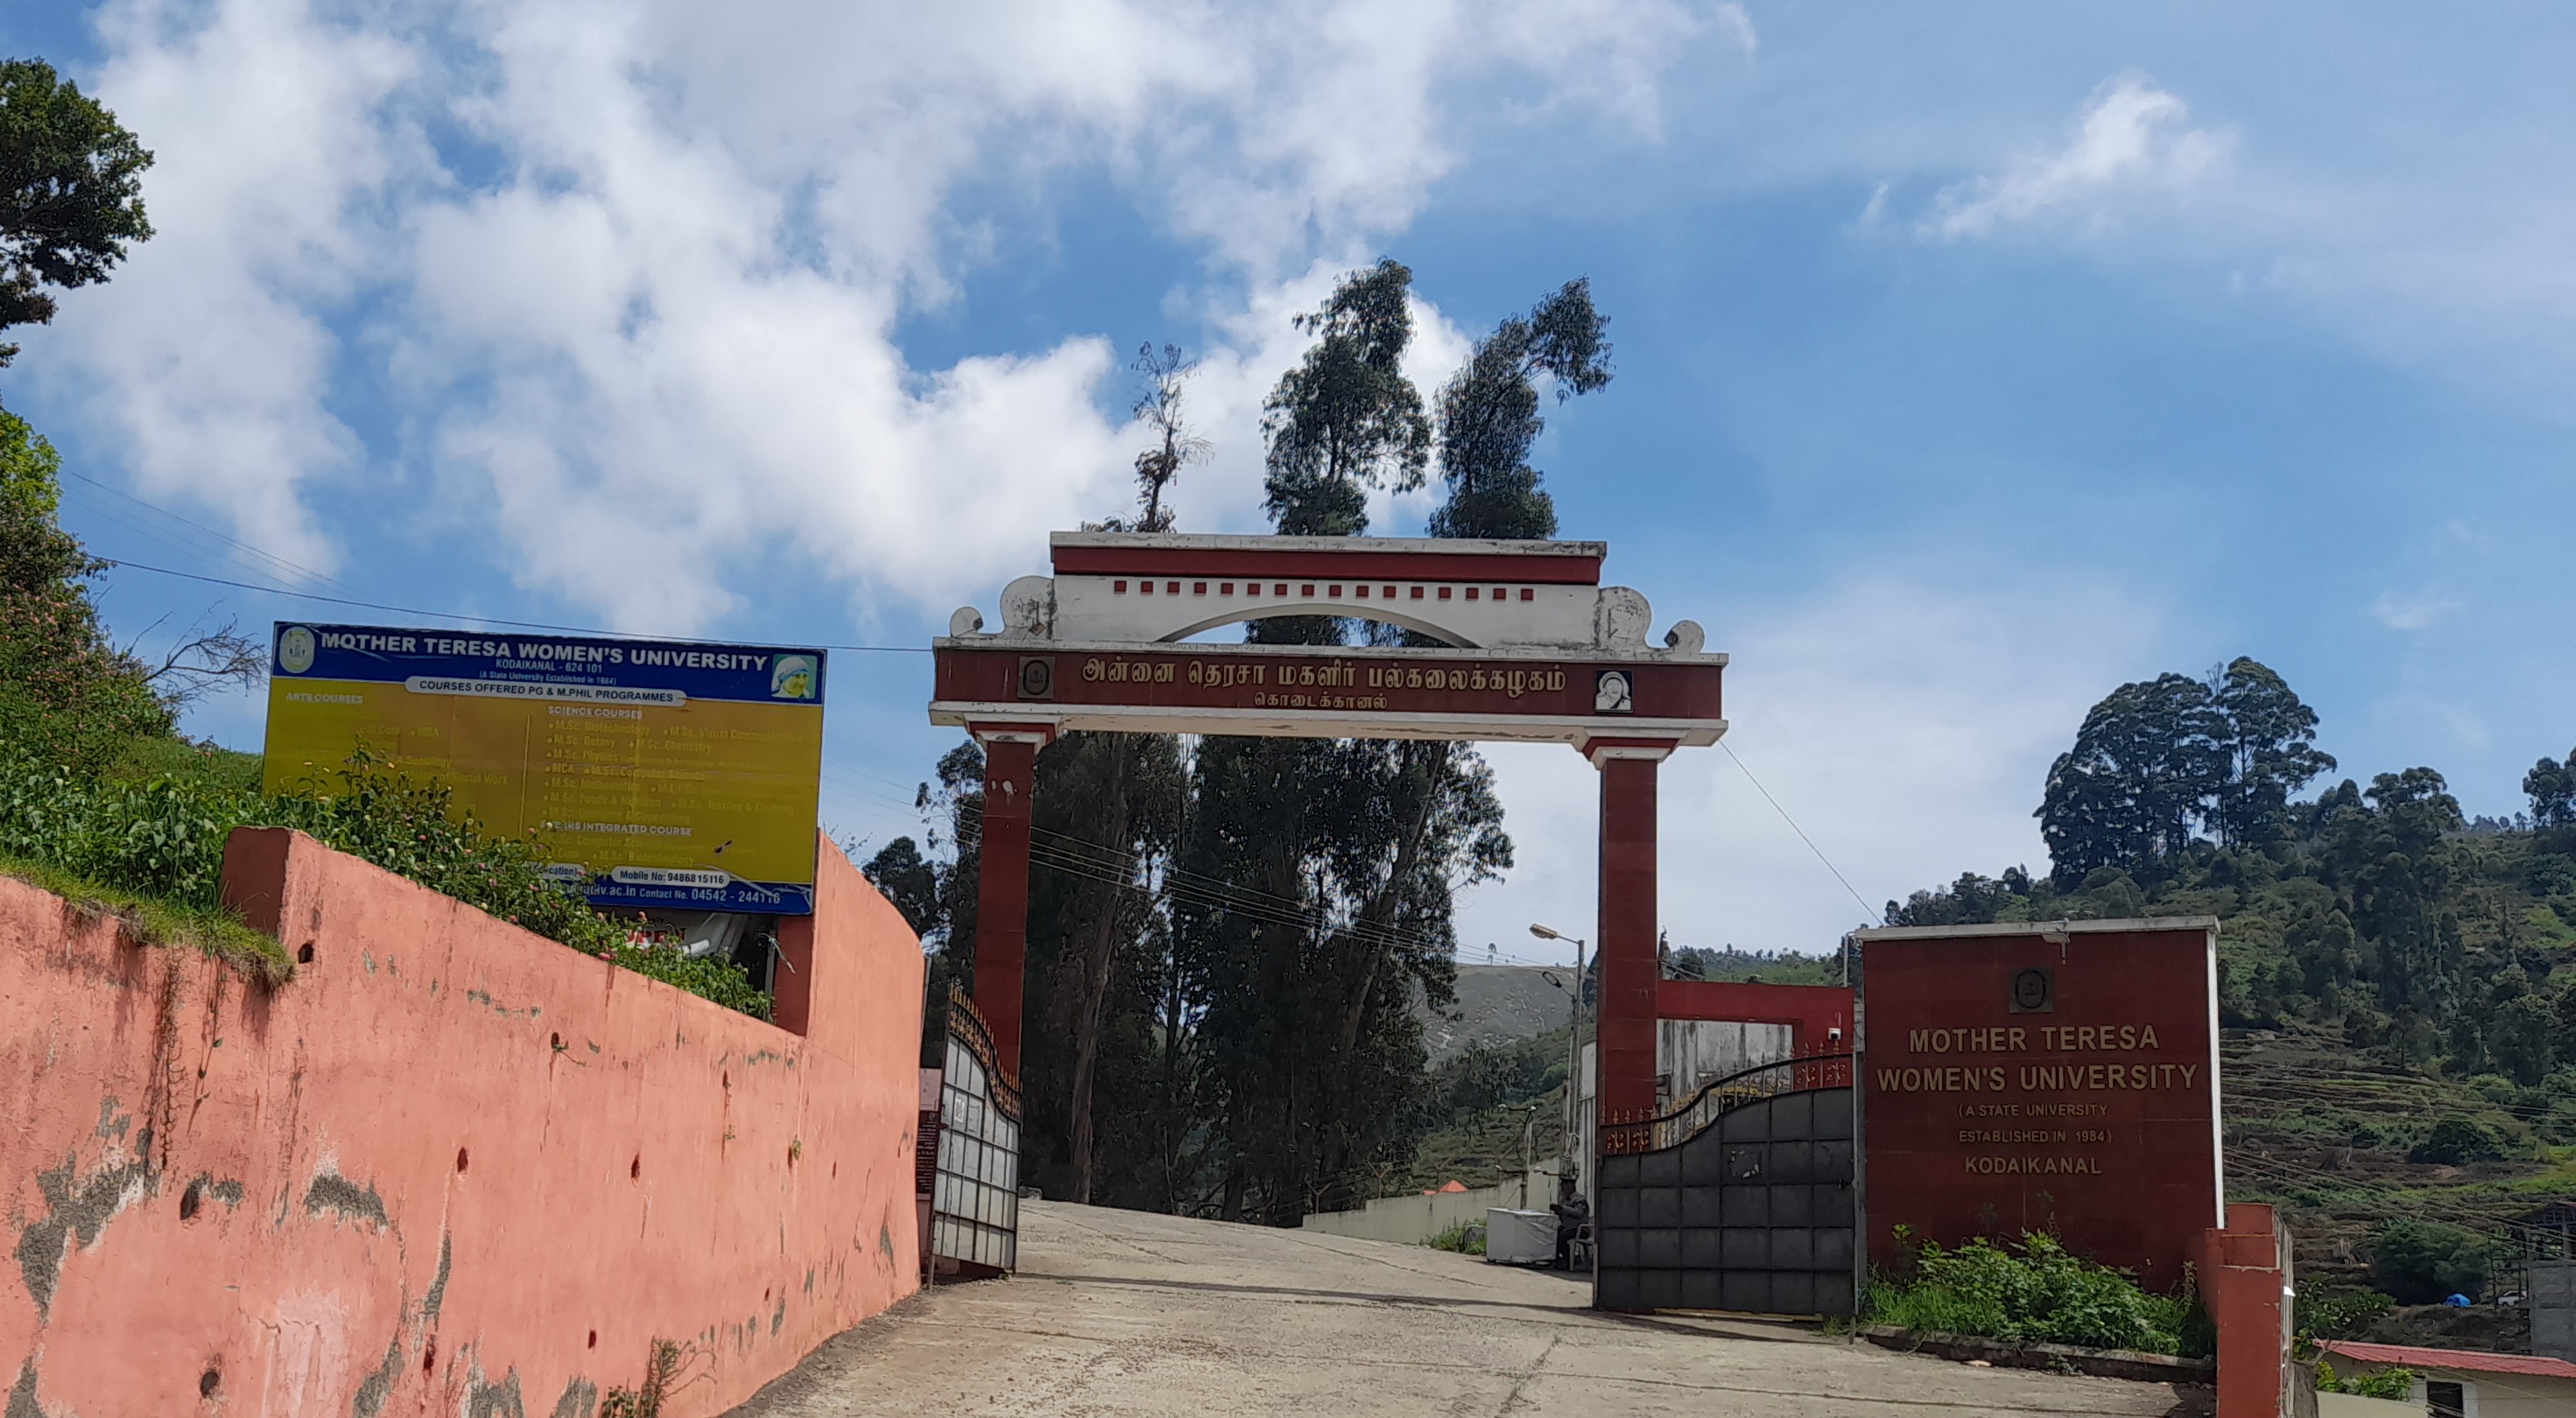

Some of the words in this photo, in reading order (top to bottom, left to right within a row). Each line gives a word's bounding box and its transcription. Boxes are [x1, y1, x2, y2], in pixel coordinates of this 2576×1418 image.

[320, 632, 416, 653] MOTHER
[424, 637, 511, 658] TERESA
[518, 643, 623, 664] WOMEN'S
[630, 649, 768, 671] UNIVERSITY
[496, 658, 556, 671] KODAIKANAL
[565, 663, 583, 672] 624
[586, 664, 602, 673] 101
[509, 672, 545, 682] University
[546, 674, 586, 683] Established
[1082, 656, 1177, 683] அன்னை
[1187, 659, 1267, 691] தெரசா
[1277, 658, 1357, 688] மகளிர்
[1369, 662, 1566, 698] பல்கலைக்கழகம்
[285, 691, 313, 702] ARTS
[314, 693, 363, 705] COURSES
[419, 680, 473, 692] COURSES
[475, 683, 525, 695] OFFERED
[528, 686, 544, 696] PG
[546, 687, 554, 696] &
[557, 688, 592, 698] M.PHIL
[595, 690, 674, 702] PROGRAMMES
[1254, 689, 1389, 710] கொடைக்கானல்
[547, 705, 593, 718] SCIENCE
[595, 708, 643, 720] COURSES
[700, 727, 728, 739] Visual
[665, 740, 714, 755] Chemistry
[582, 750, 618, 762] Physics
[552, 763, 574, 774] MCA
[620, 767, 666, 779] Computer
[483, 773, 509, 785] Work
[582, 822, 648, 833] INTEGRATED
[649, 825, 693, 837] COURSE
[576, 834, 622, 847] Computer
[620, 870, 649, 881] Mobile
[639, 888, 672, 899] Contact
[674, 890, 689, 900] No.
[691, 888, 727, 902] 04542
[1909, 1026, 2028, 1053] MOTHER
[2040, 1023, 2160, 1051] TERESA
[1876, 1065, 2007, 1092] WOMEN'S
[2019, 1063, 2199, 1091] UNIVERSITY
[1979, 1105, 2020, 1116] STATE
[2026, 1104, 2108, 1117] UNIVERSITY
[1959, 1130, 2049, 1143] ESTABLISHED
[2052, 1130, 2066, 1143] IN
[2075, 1129, 2113, 1143] 1984)
[1964, 1156, 2103, 1175] KODAIKANAL
